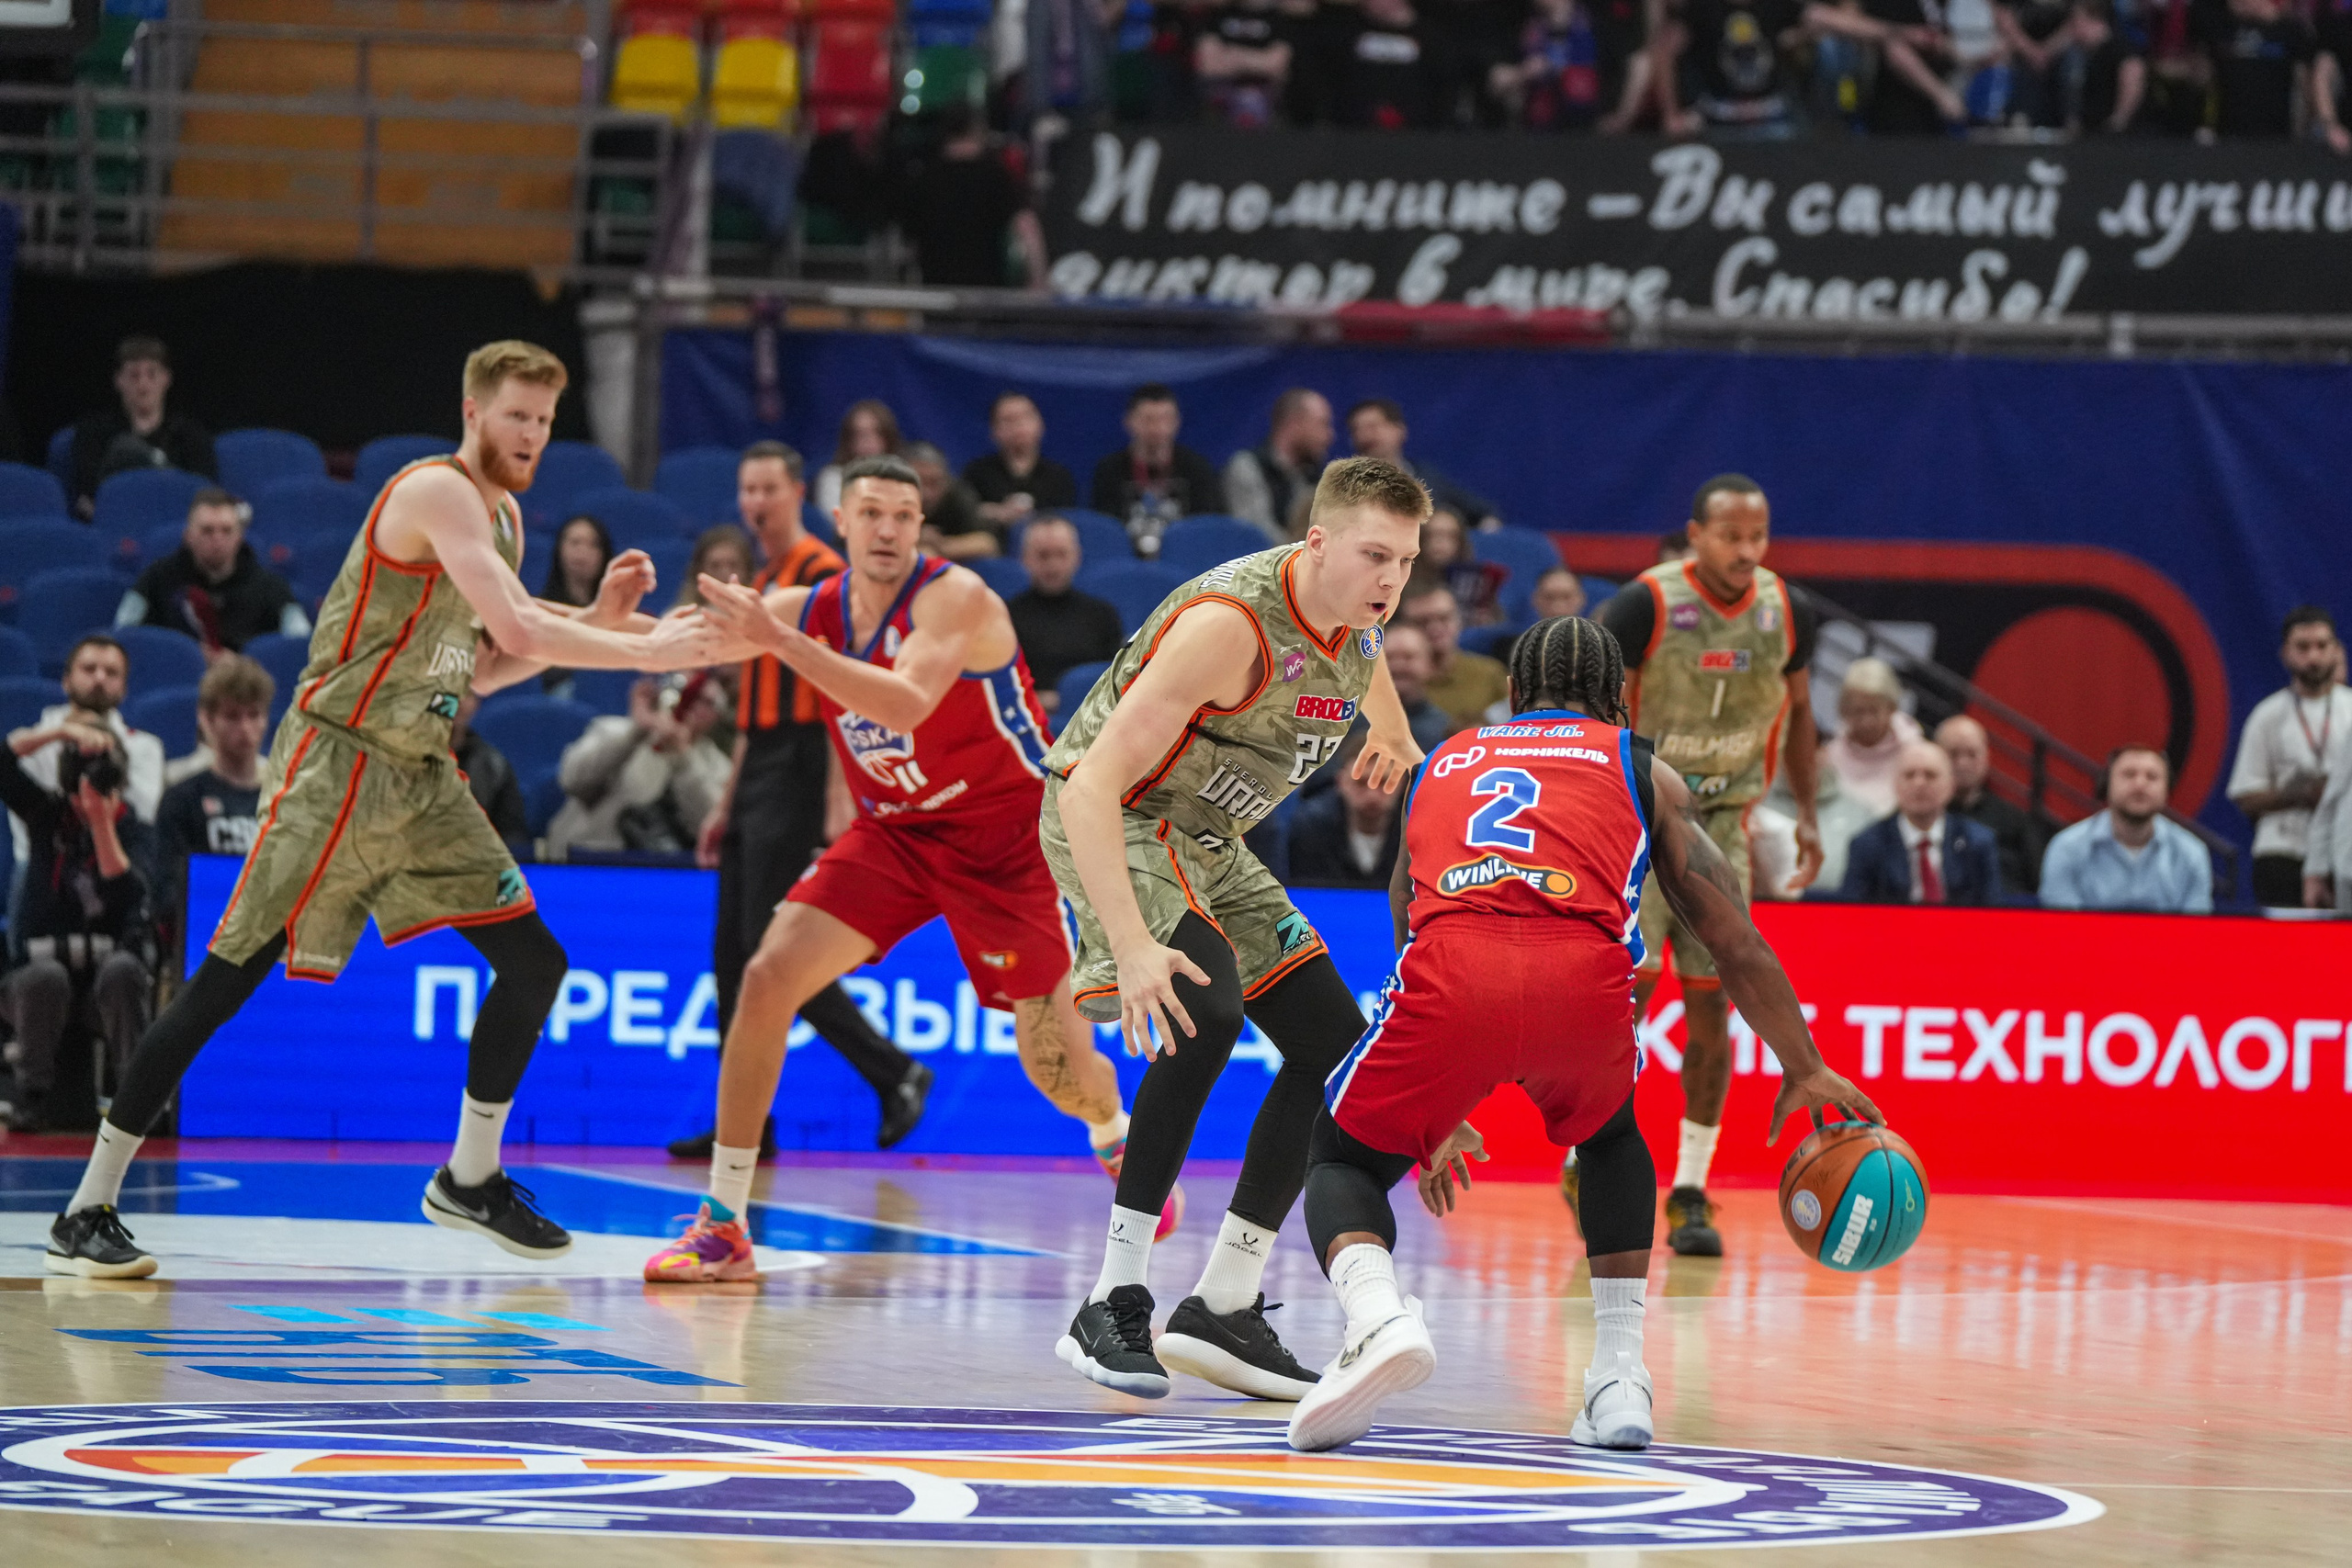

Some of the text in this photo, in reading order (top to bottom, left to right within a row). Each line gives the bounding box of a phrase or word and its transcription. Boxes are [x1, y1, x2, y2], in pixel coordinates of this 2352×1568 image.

[1078, 132, 1161, 231] И
[1167, 178, 1567, 234] помните
[1786, 157, 2065, 237] самый
[1711, 233, 2090, 323] Спасибо!
[1476, 725, 1543, 739] WARE
[1494, 747, 1610, 764] НОРНИКЕЛЬ
[1465, 767, 1542, 853] 2
[414, 965, 1018, 1058] ПРЕДВЫ
[1843, 1004, 2352, 1092] ТЕХНОЛОГ
